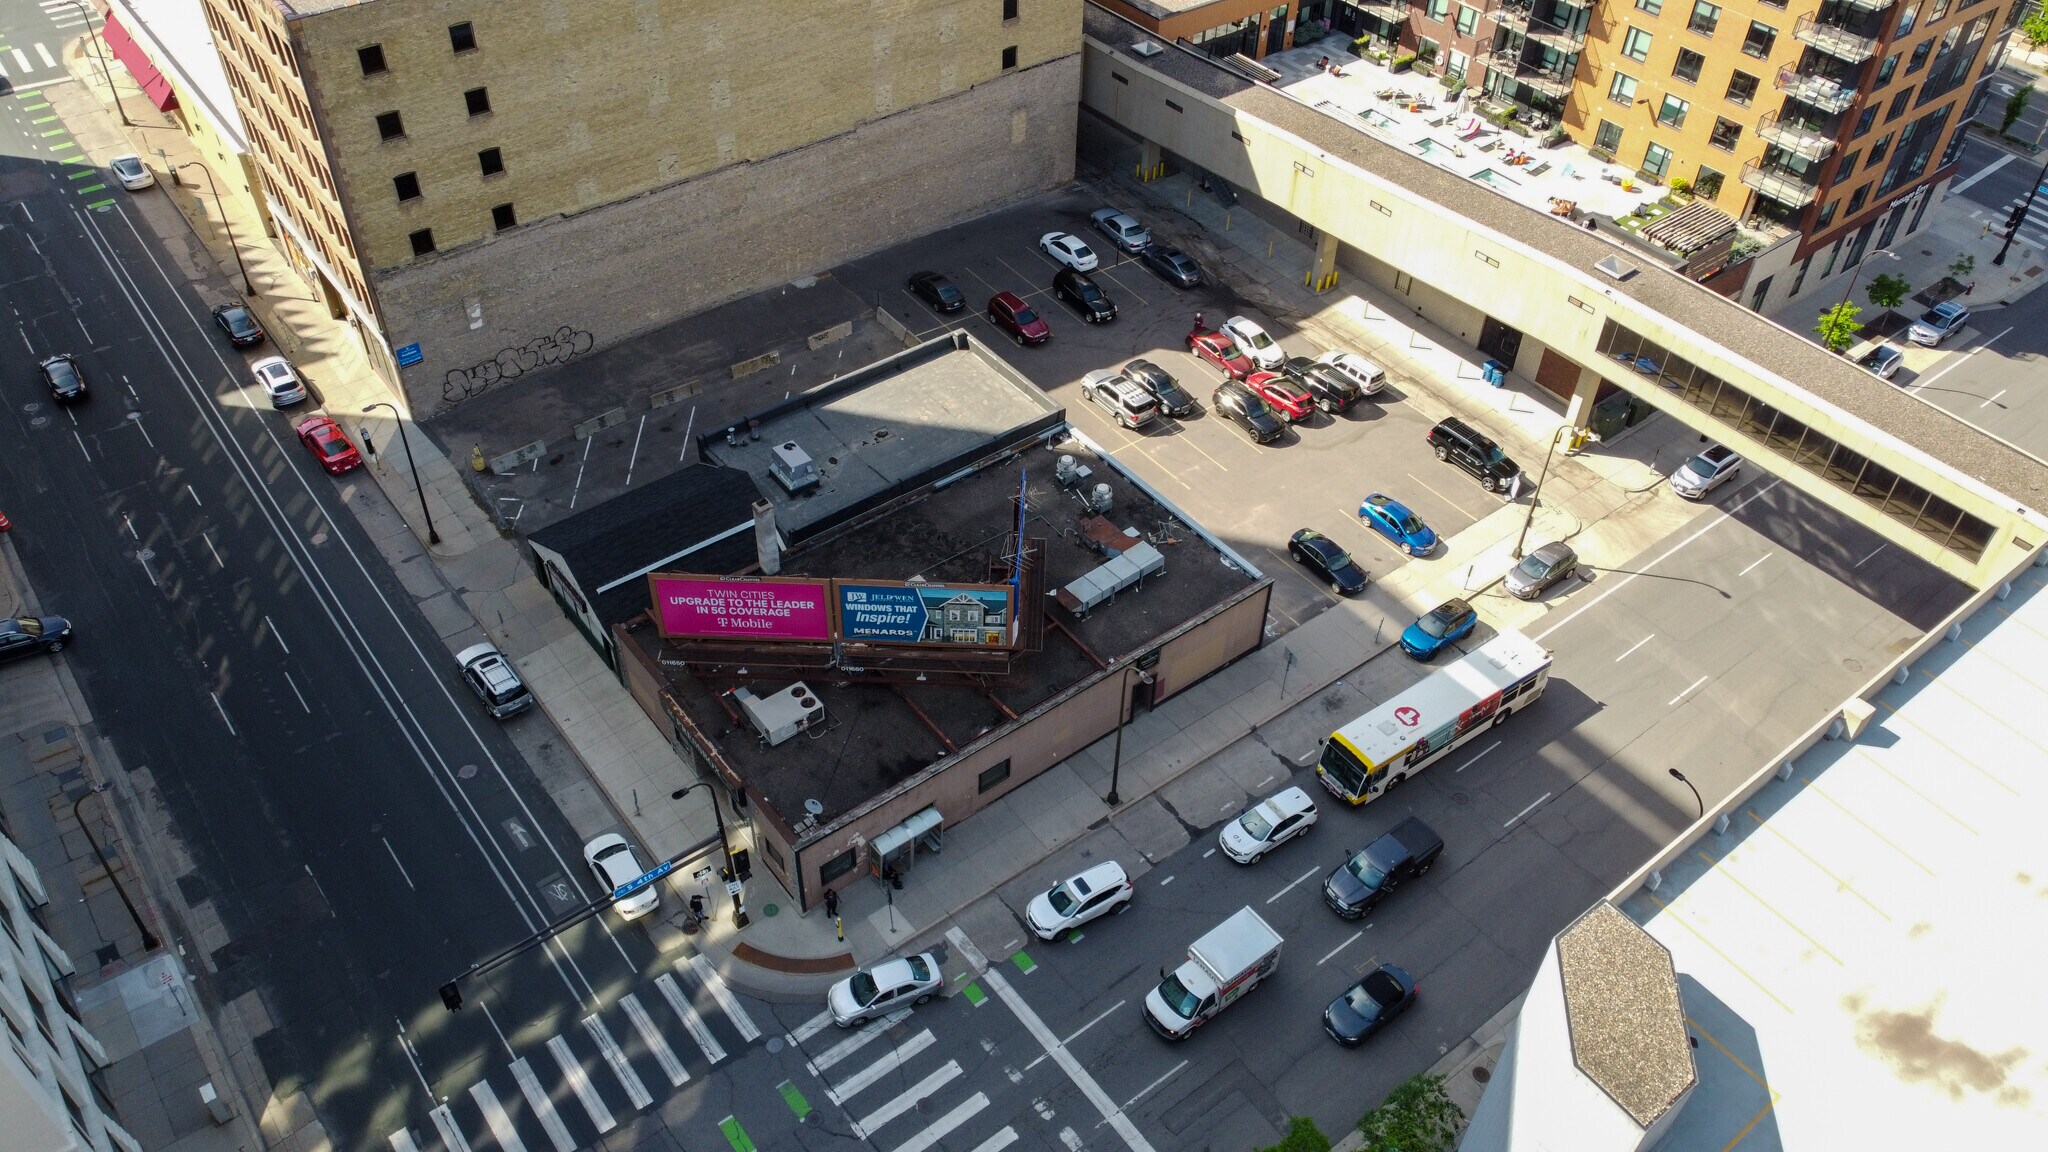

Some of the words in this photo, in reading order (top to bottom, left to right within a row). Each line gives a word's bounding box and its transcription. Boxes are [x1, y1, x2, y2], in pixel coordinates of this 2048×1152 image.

[707, 589, 738, 598] TWIN
[740, 590, 775, 600] CITIES
[669, 596, 726, 606] UPGRADE
[728, 598, 743, 607] TO
[745, 599, 769, 608] THE
[770, 600, 815, 609] LEADER
[845, 603, 892, 612] WINDOWS
[894, 605, 918, 613] THAT
[696, 606, 709, 614] IN
[711, 607, 727, 615] 5G
[729, 607, 791, 617] COVERAGE
[731, 617, 773, 629] Mobile
[855, 611, 911, 625] Inspire!
[853, 627, 913, 636] MENARDS
[626, 883, 633, 891] S
[637, 873, 654, 885] 4th
[657, 865, 669, 875] Av
